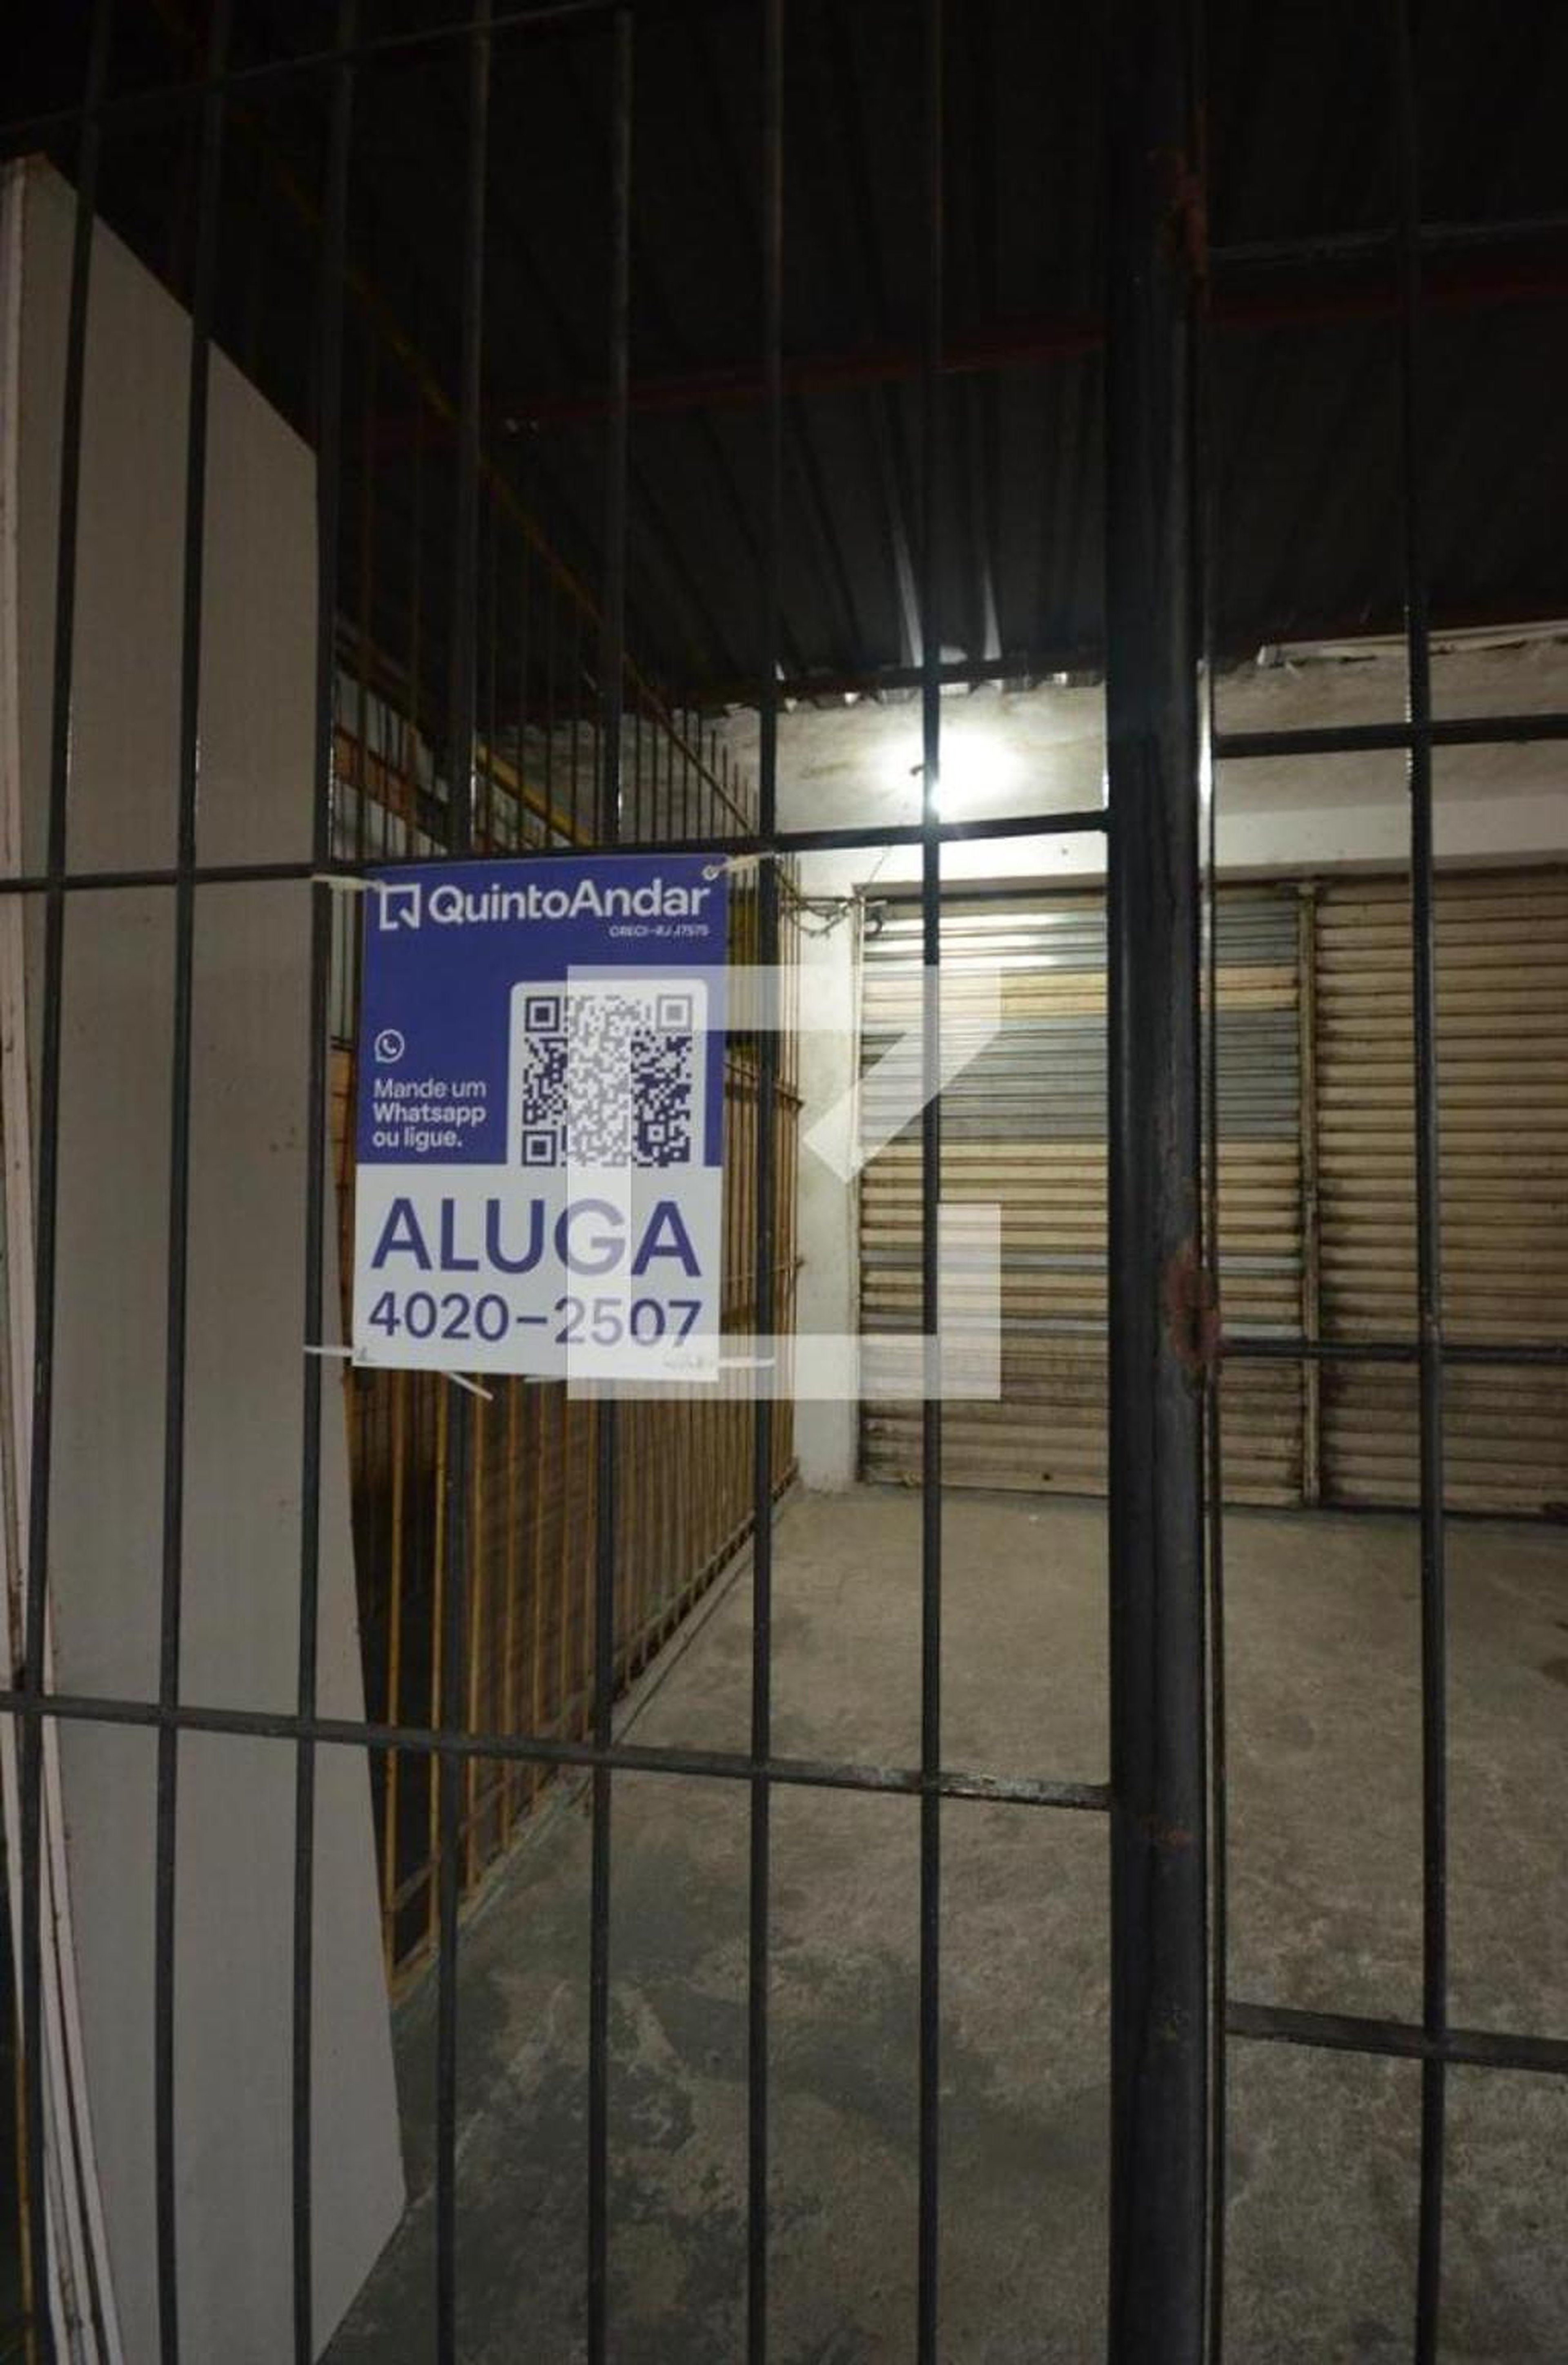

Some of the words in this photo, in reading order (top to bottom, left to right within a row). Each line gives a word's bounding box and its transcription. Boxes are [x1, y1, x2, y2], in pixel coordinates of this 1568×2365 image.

[428, 879, 710, 924] QuintoAndar
[374, 1078, 447, 1098] Mande
[452, 1082, 486, 1098] um
[373, 1102, 486, 1127] Whatsapp
[372, 1131, 399, 1147] ou
[404, 1126, 462, 1152] ligue.
[371, 1197, 702, 1277] ALUGA
[369, 1291, 702, 1348] 4020-2507
